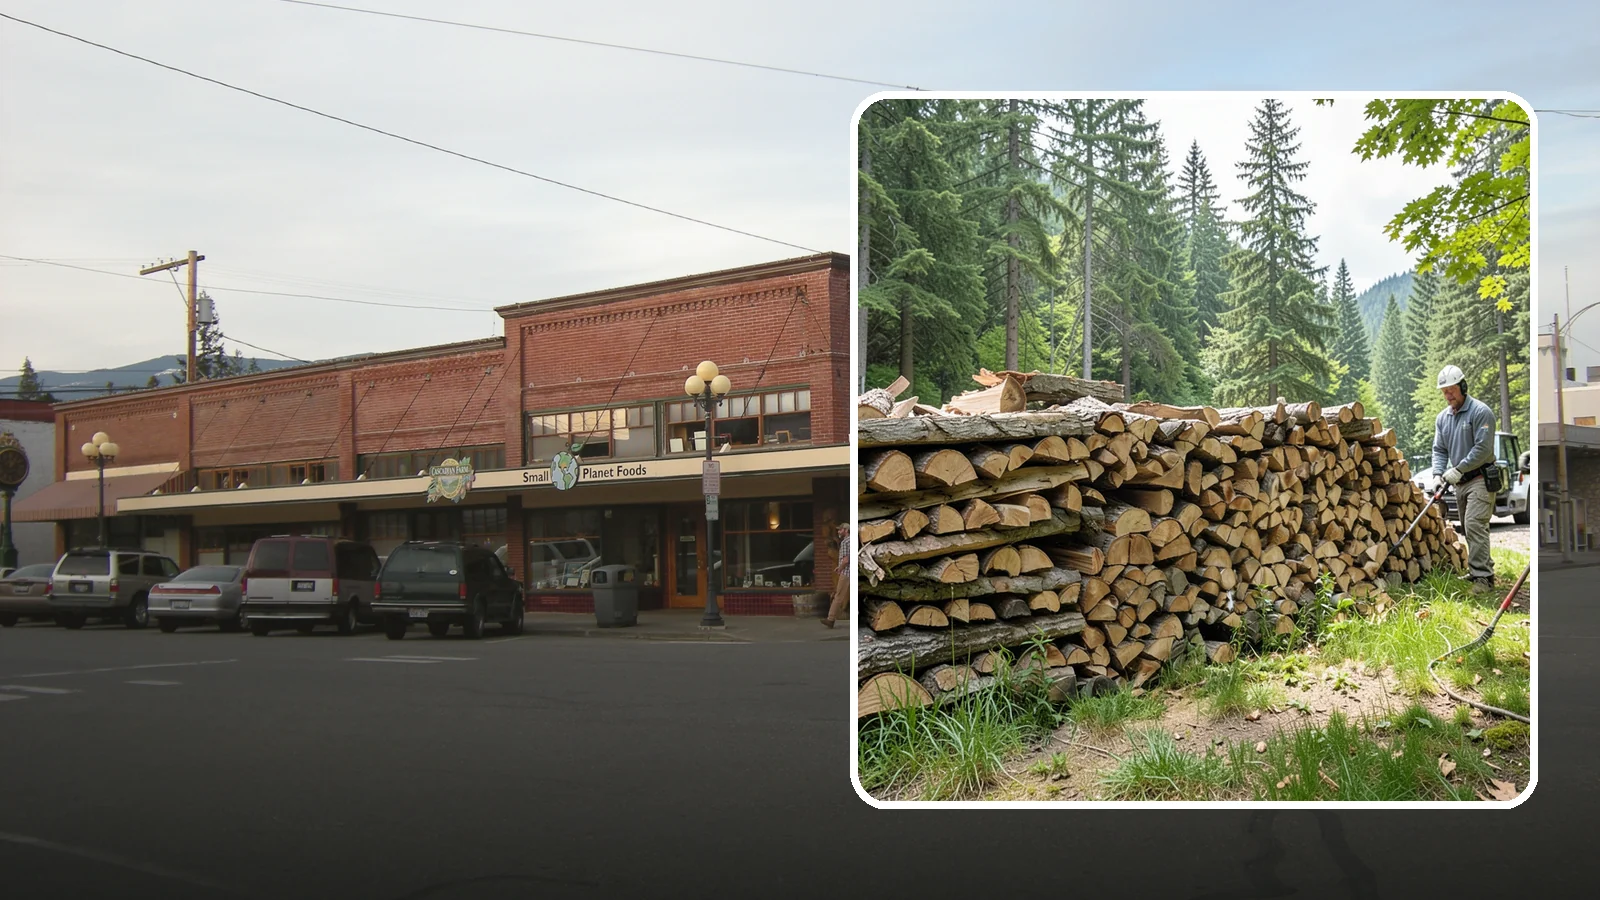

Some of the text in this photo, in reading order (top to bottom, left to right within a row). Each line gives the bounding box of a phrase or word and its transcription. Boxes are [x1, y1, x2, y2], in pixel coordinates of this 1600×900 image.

[431, 466, 469, 476] CASCADIAN FARM
[523, 464, 647, 483] Small Planet Foods
